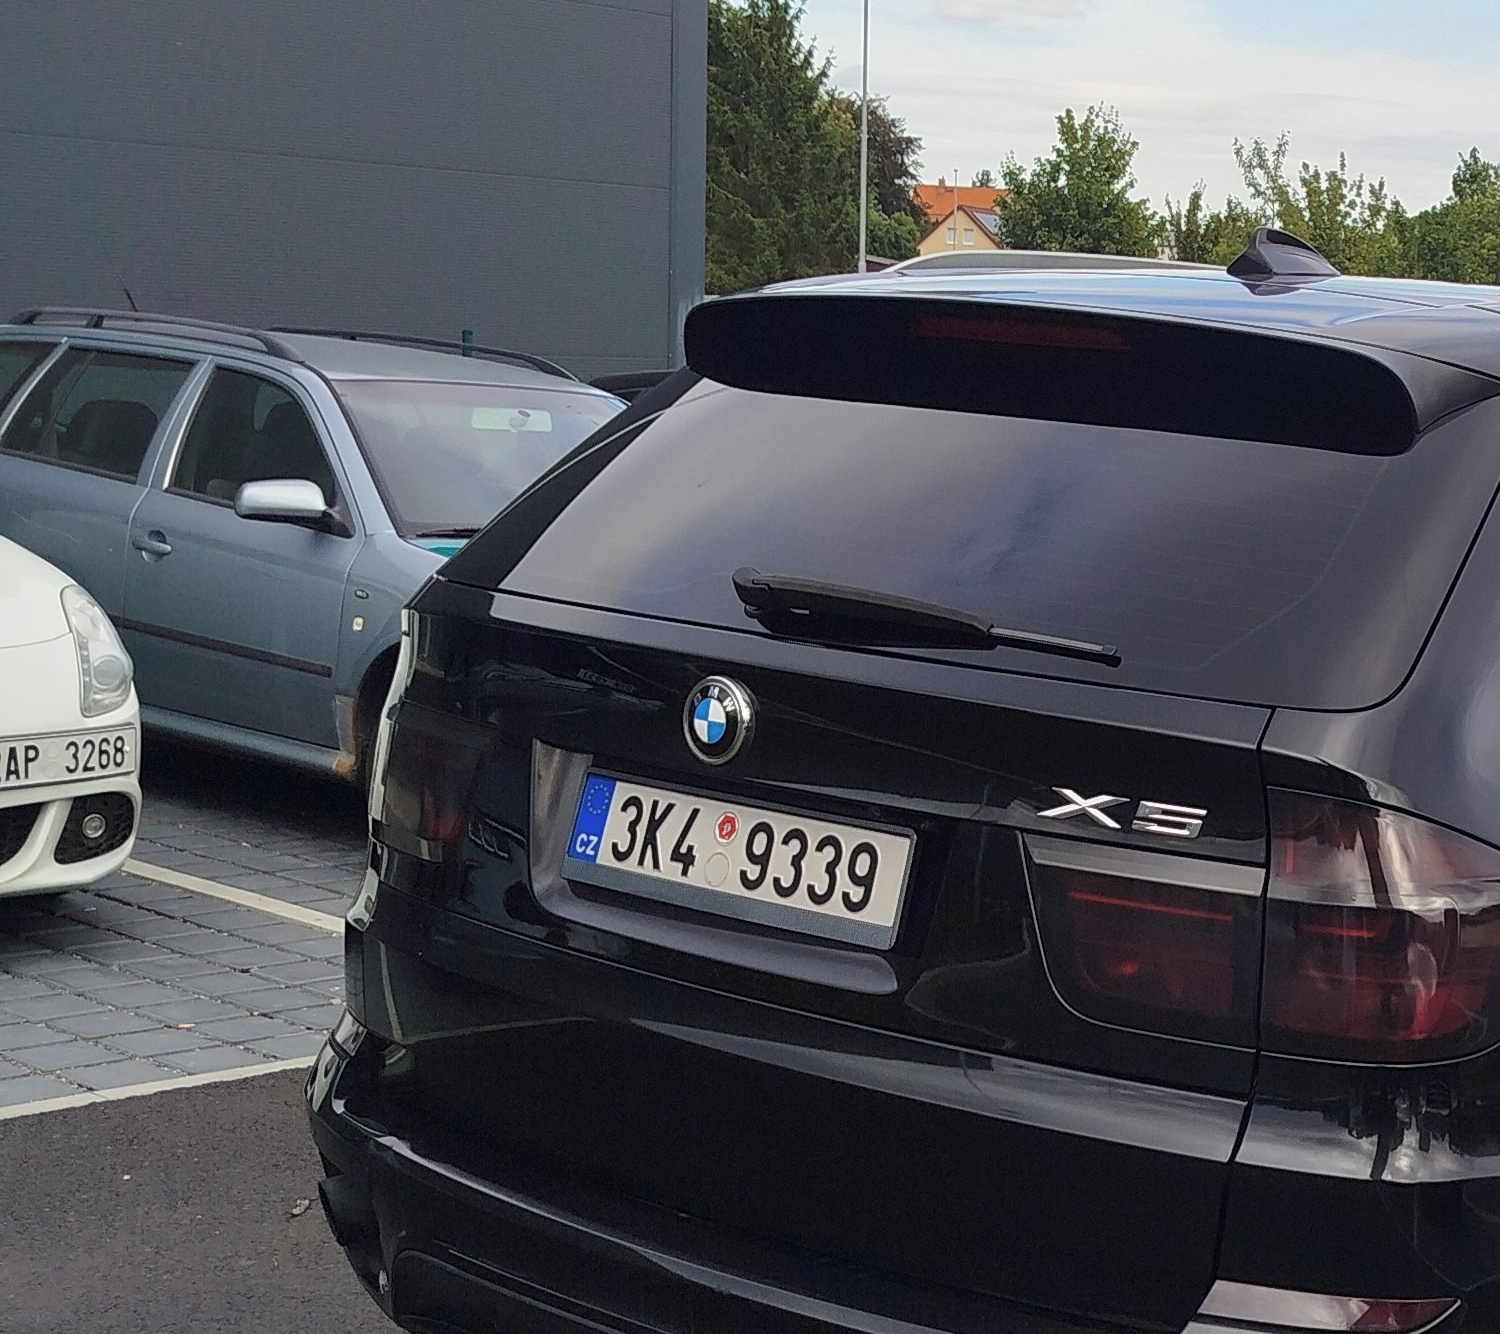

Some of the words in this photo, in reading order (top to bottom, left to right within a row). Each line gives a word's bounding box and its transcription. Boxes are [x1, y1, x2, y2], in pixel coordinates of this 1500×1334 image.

[693, 685, 736, 713] BMW
[0, 744, 40, 782] AP
[64, 735, 126, 775] 3268
[1035, 786, 1208, 840] X5
[574, 832, 598, 856] CZ
[610, 795, 701, 878] 3K4
[738, 820, 880, 914] 9339
